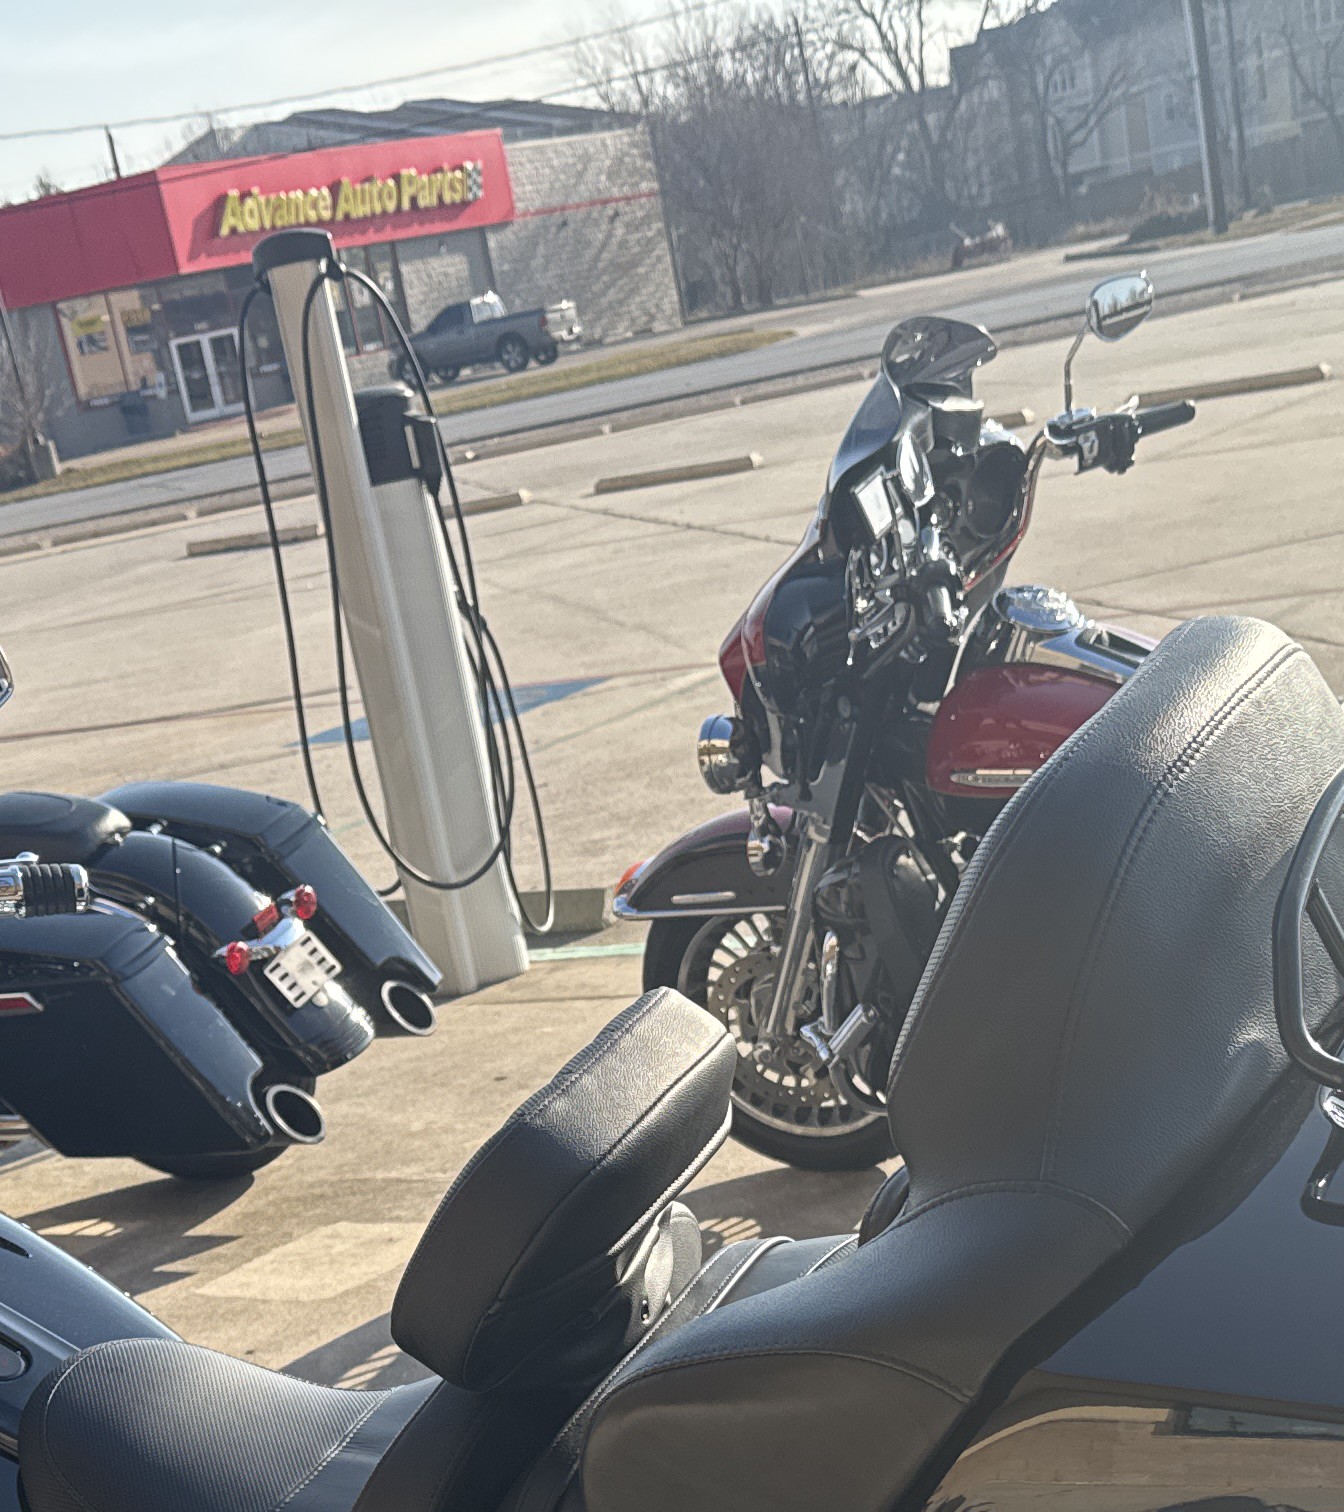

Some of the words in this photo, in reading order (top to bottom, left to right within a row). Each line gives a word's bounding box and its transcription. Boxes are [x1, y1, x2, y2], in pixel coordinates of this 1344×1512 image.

[220, 186, 333, 237] Advance
[334, 176, 397, 222] Auto
[399, 166, 464, 211] Parts
